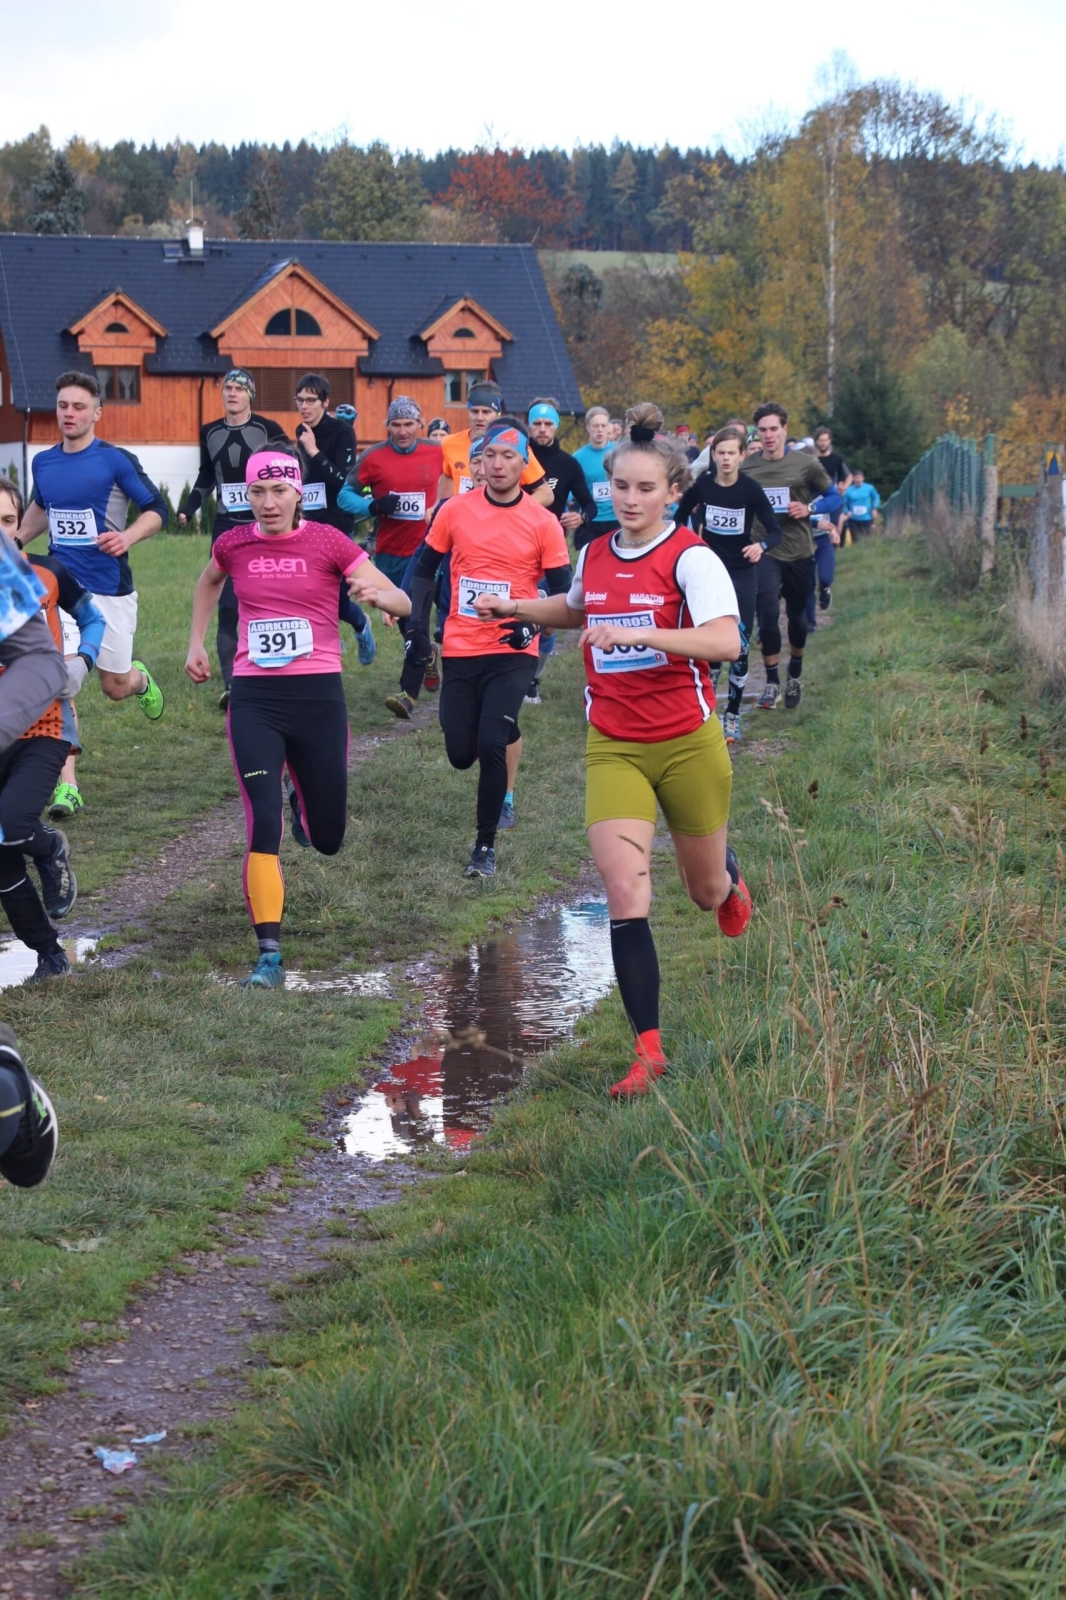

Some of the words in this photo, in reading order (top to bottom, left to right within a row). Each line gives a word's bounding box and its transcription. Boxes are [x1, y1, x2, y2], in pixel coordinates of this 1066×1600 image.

[257, 464, 300, 480] eleven
[57, 520, 87, 535] 532
[712, 515, 738, 528] 528
[248, 556, 307, 573] eleven
[629, 593, 665, 602] MARATON
[258, 631, 297, 653] 391
[243, 770, 263, 778] CRAFT
